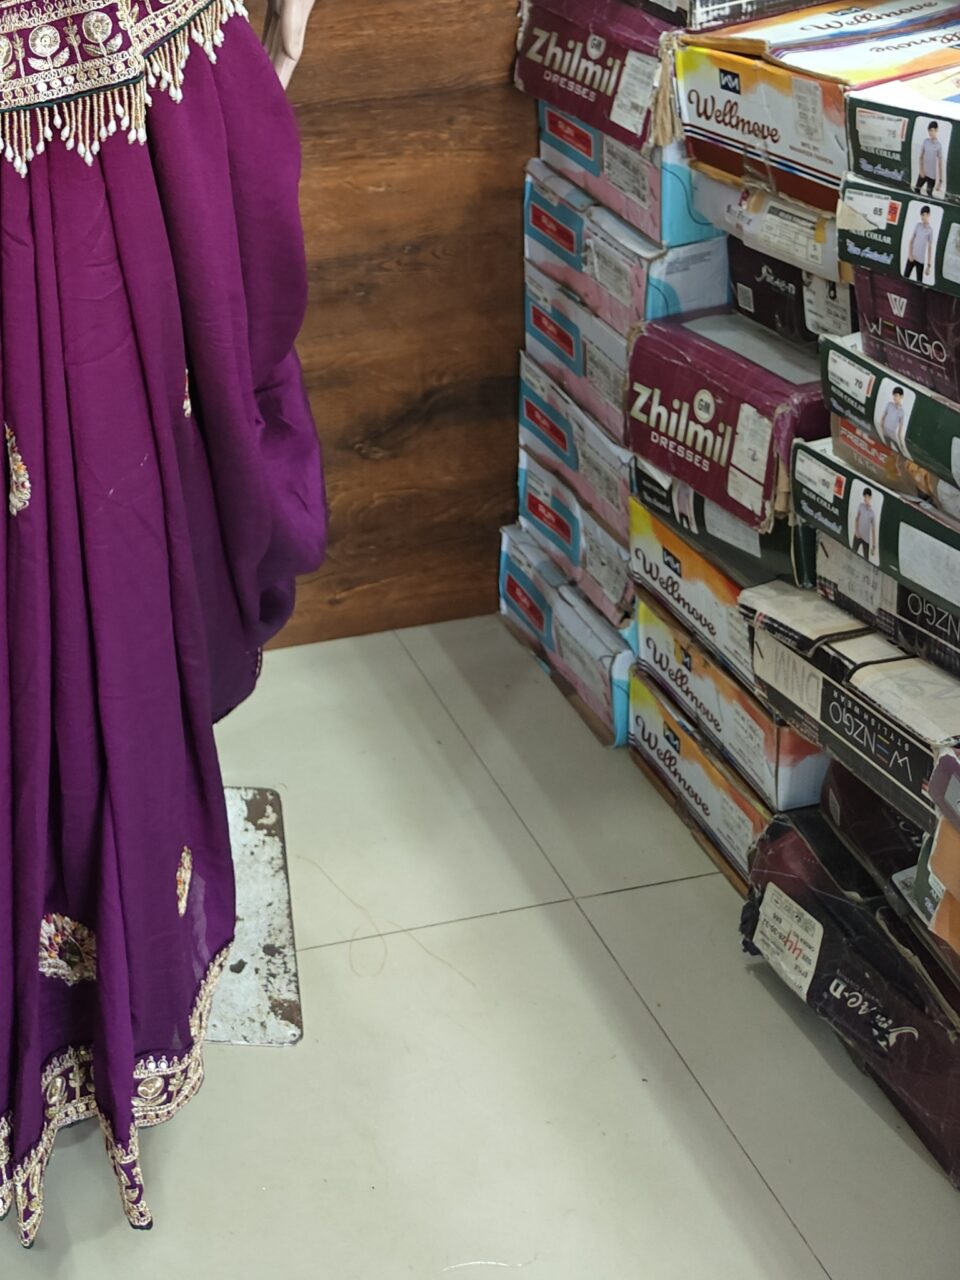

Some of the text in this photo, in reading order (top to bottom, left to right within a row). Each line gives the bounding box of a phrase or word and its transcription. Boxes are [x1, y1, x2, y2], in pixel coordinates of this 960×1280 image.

[799, 1, 938, 31] Wellmove
[525, 27, 621, 97] Zhilmil
[543, 70, 597, 102] DRESSES
[687, 89, 781, 144] Wellmove
[630, 381, 733, 467] Zhilmil
[650, 431, 710, 472] DRESSES
[635, 547, 717, 637] Wellmove
[646, 637, 722, 732] Wellmove
[829, 701, 912, 782] WENZGO
[832, 689, 910, 752] STYLISH WEAR
[635, 715, 711, 817] Wellmove
